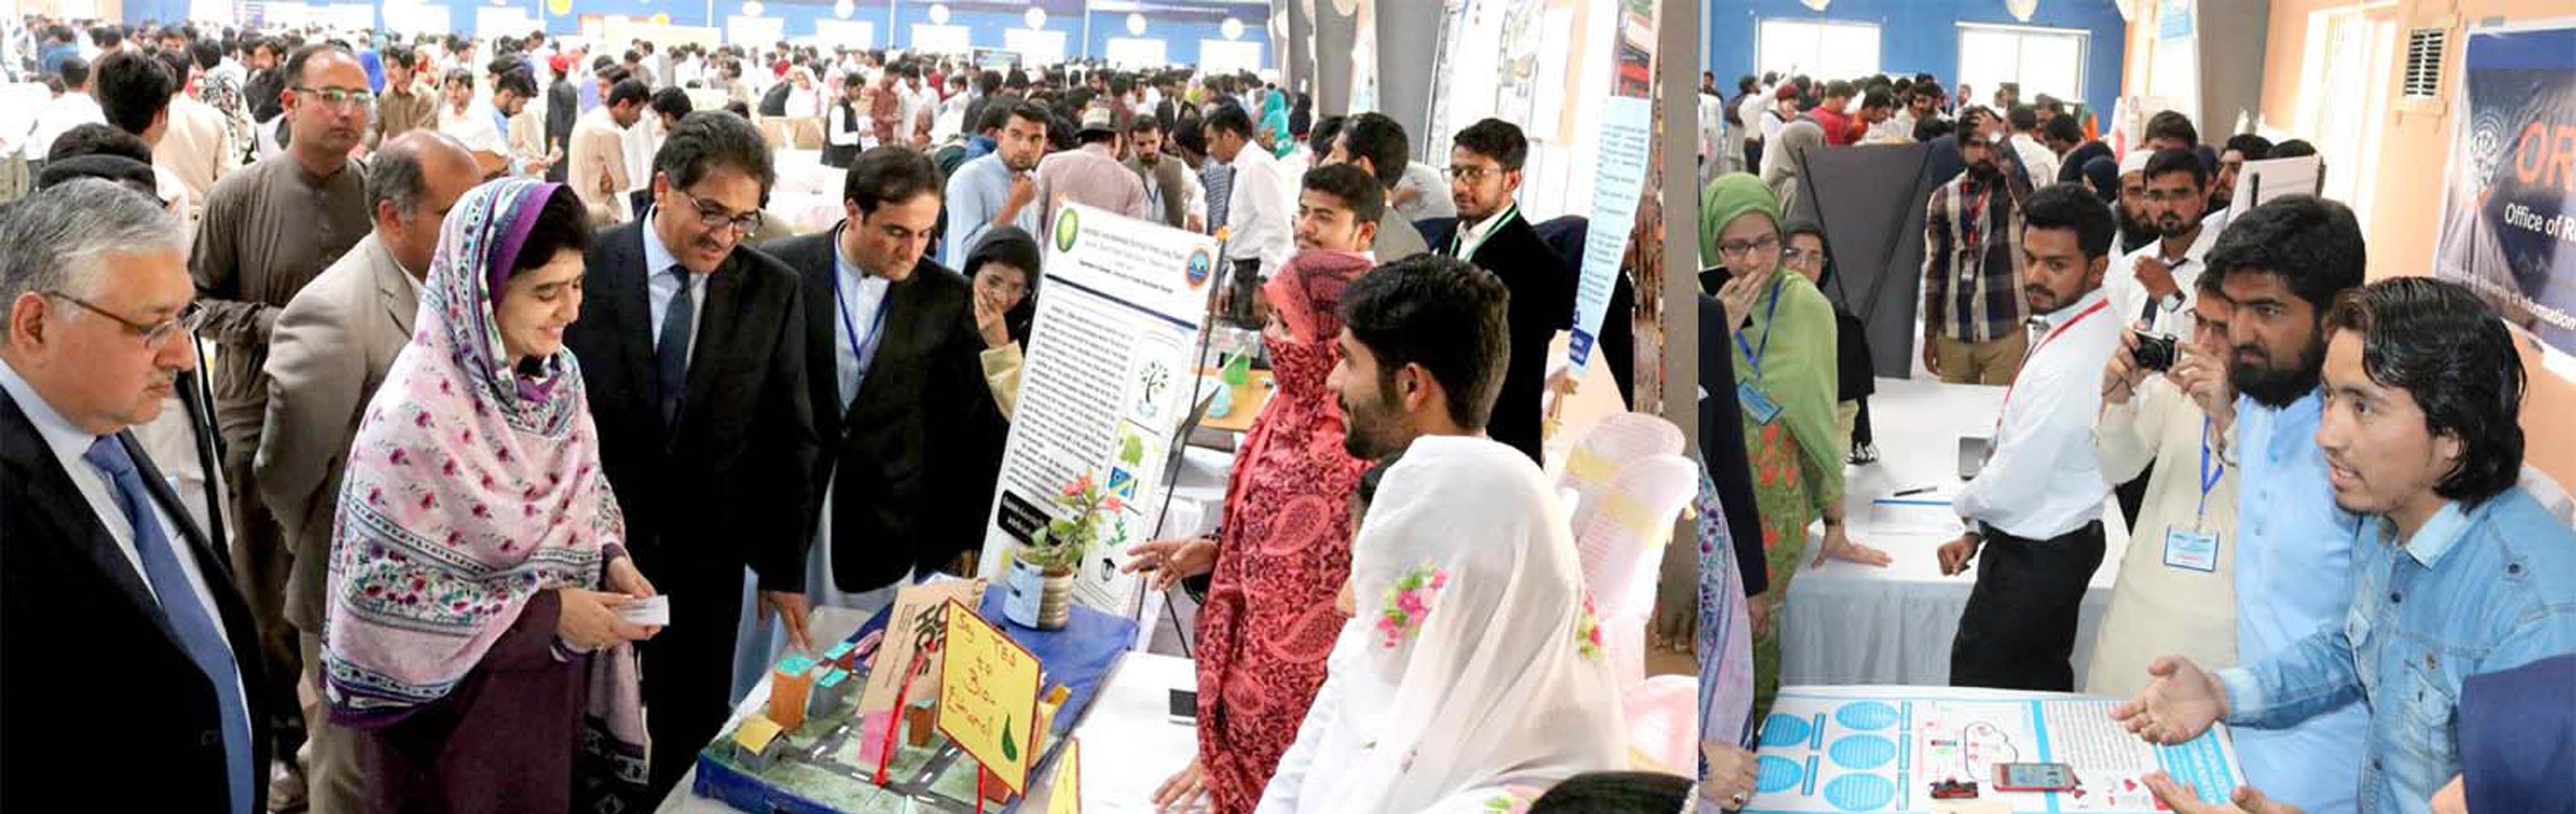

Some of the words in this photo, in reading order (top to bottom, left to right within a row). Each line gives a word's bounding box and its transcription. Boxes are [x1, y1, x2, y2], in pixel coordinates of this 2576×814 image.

[2505, 202, 2543, 232] Office
[2546, 215, 2563, 236] of
[2562, 217, 2576, 242] R
